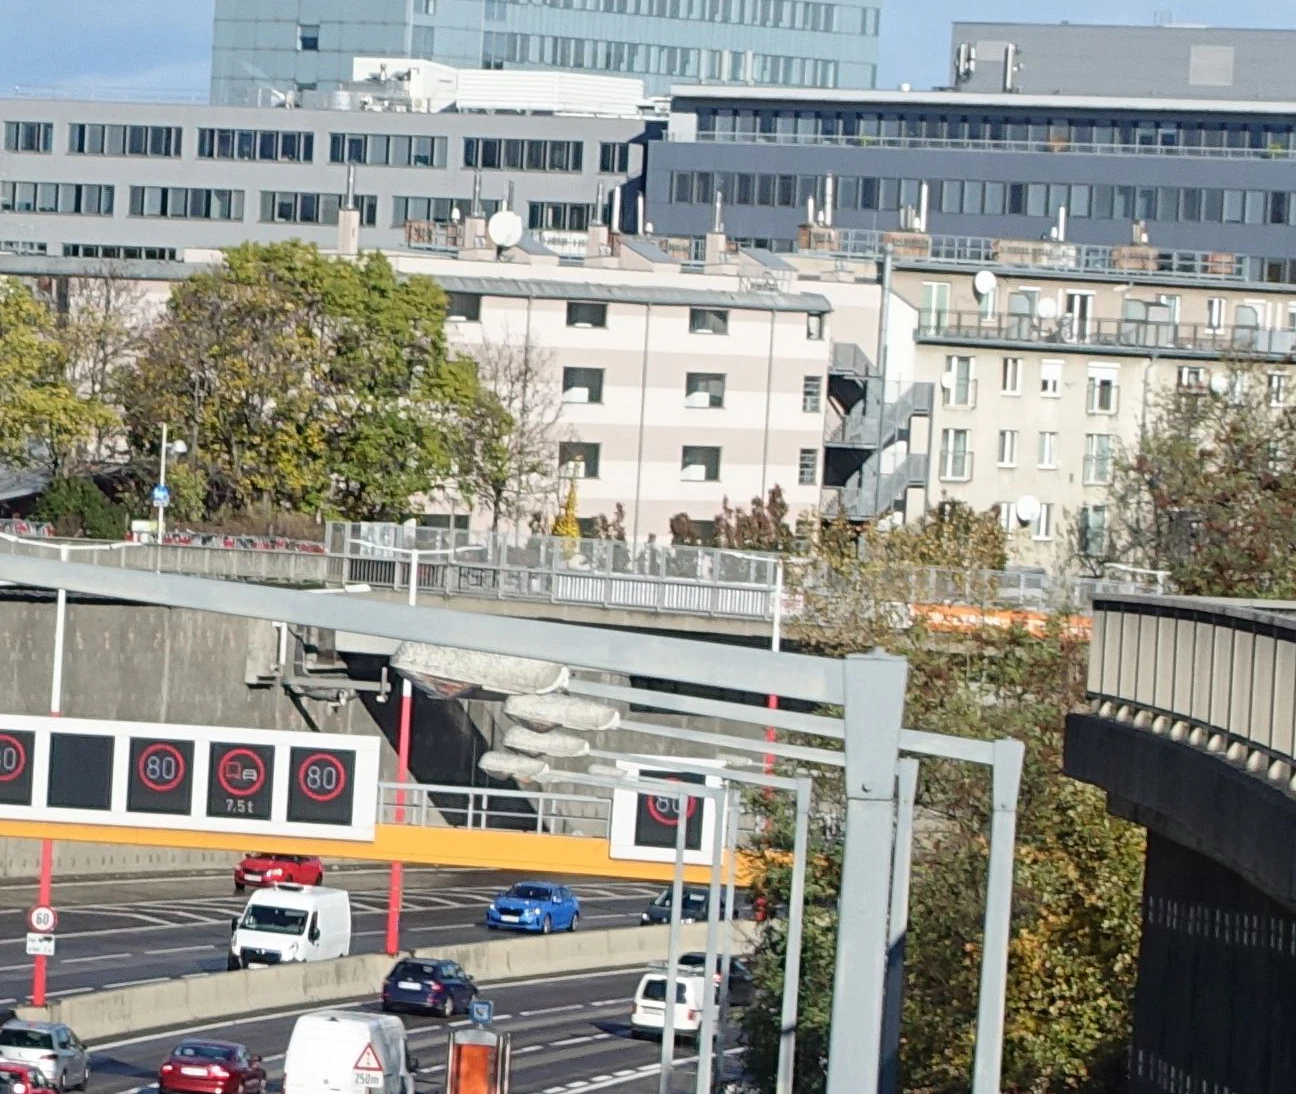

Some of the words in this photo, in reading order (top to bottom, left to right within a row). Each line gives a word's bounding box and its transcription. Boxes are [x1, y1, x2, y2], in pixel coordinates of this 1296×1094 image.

[146, 755, 176, 779] 80
[307, 765, 337, 790] 80
[36, 912, 50, 926] 60
